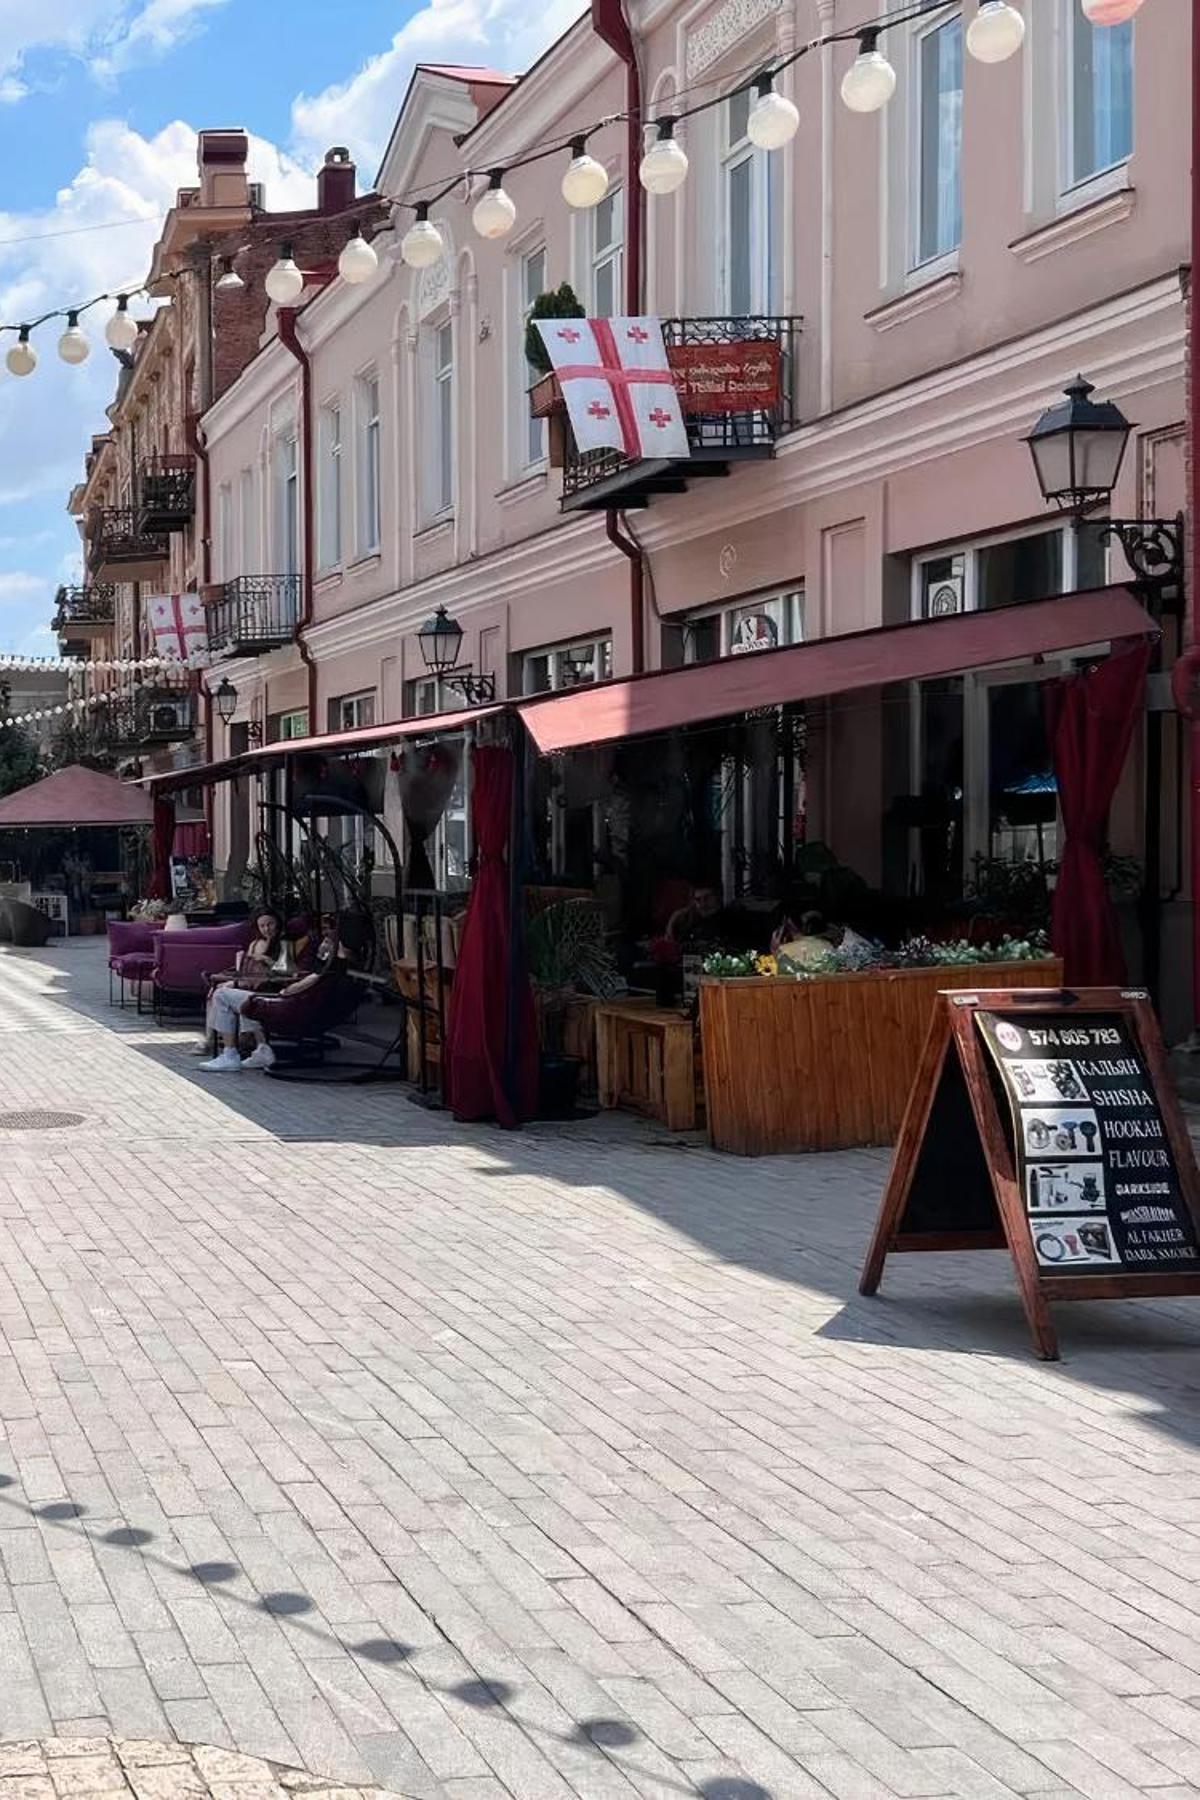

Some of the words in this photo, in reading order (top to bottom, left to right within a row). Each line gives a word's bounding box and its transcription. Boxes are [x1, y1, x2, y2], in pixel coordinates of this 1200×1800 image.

[1027, 1028, 1060, 1045] 574
[1089, 1027, 1121, 1045] 783
[1076, 1059, 1142, 1077] КАЛЬЯН
[1092, 1089, 1154, 1107] SHISHA
[1104, 1119, 1163, 1139] HOOKAH
[1108, 1149, 1170, 1168] FLAVOUR
[1115, 1182, 1171, 1196] DARKSIDE
